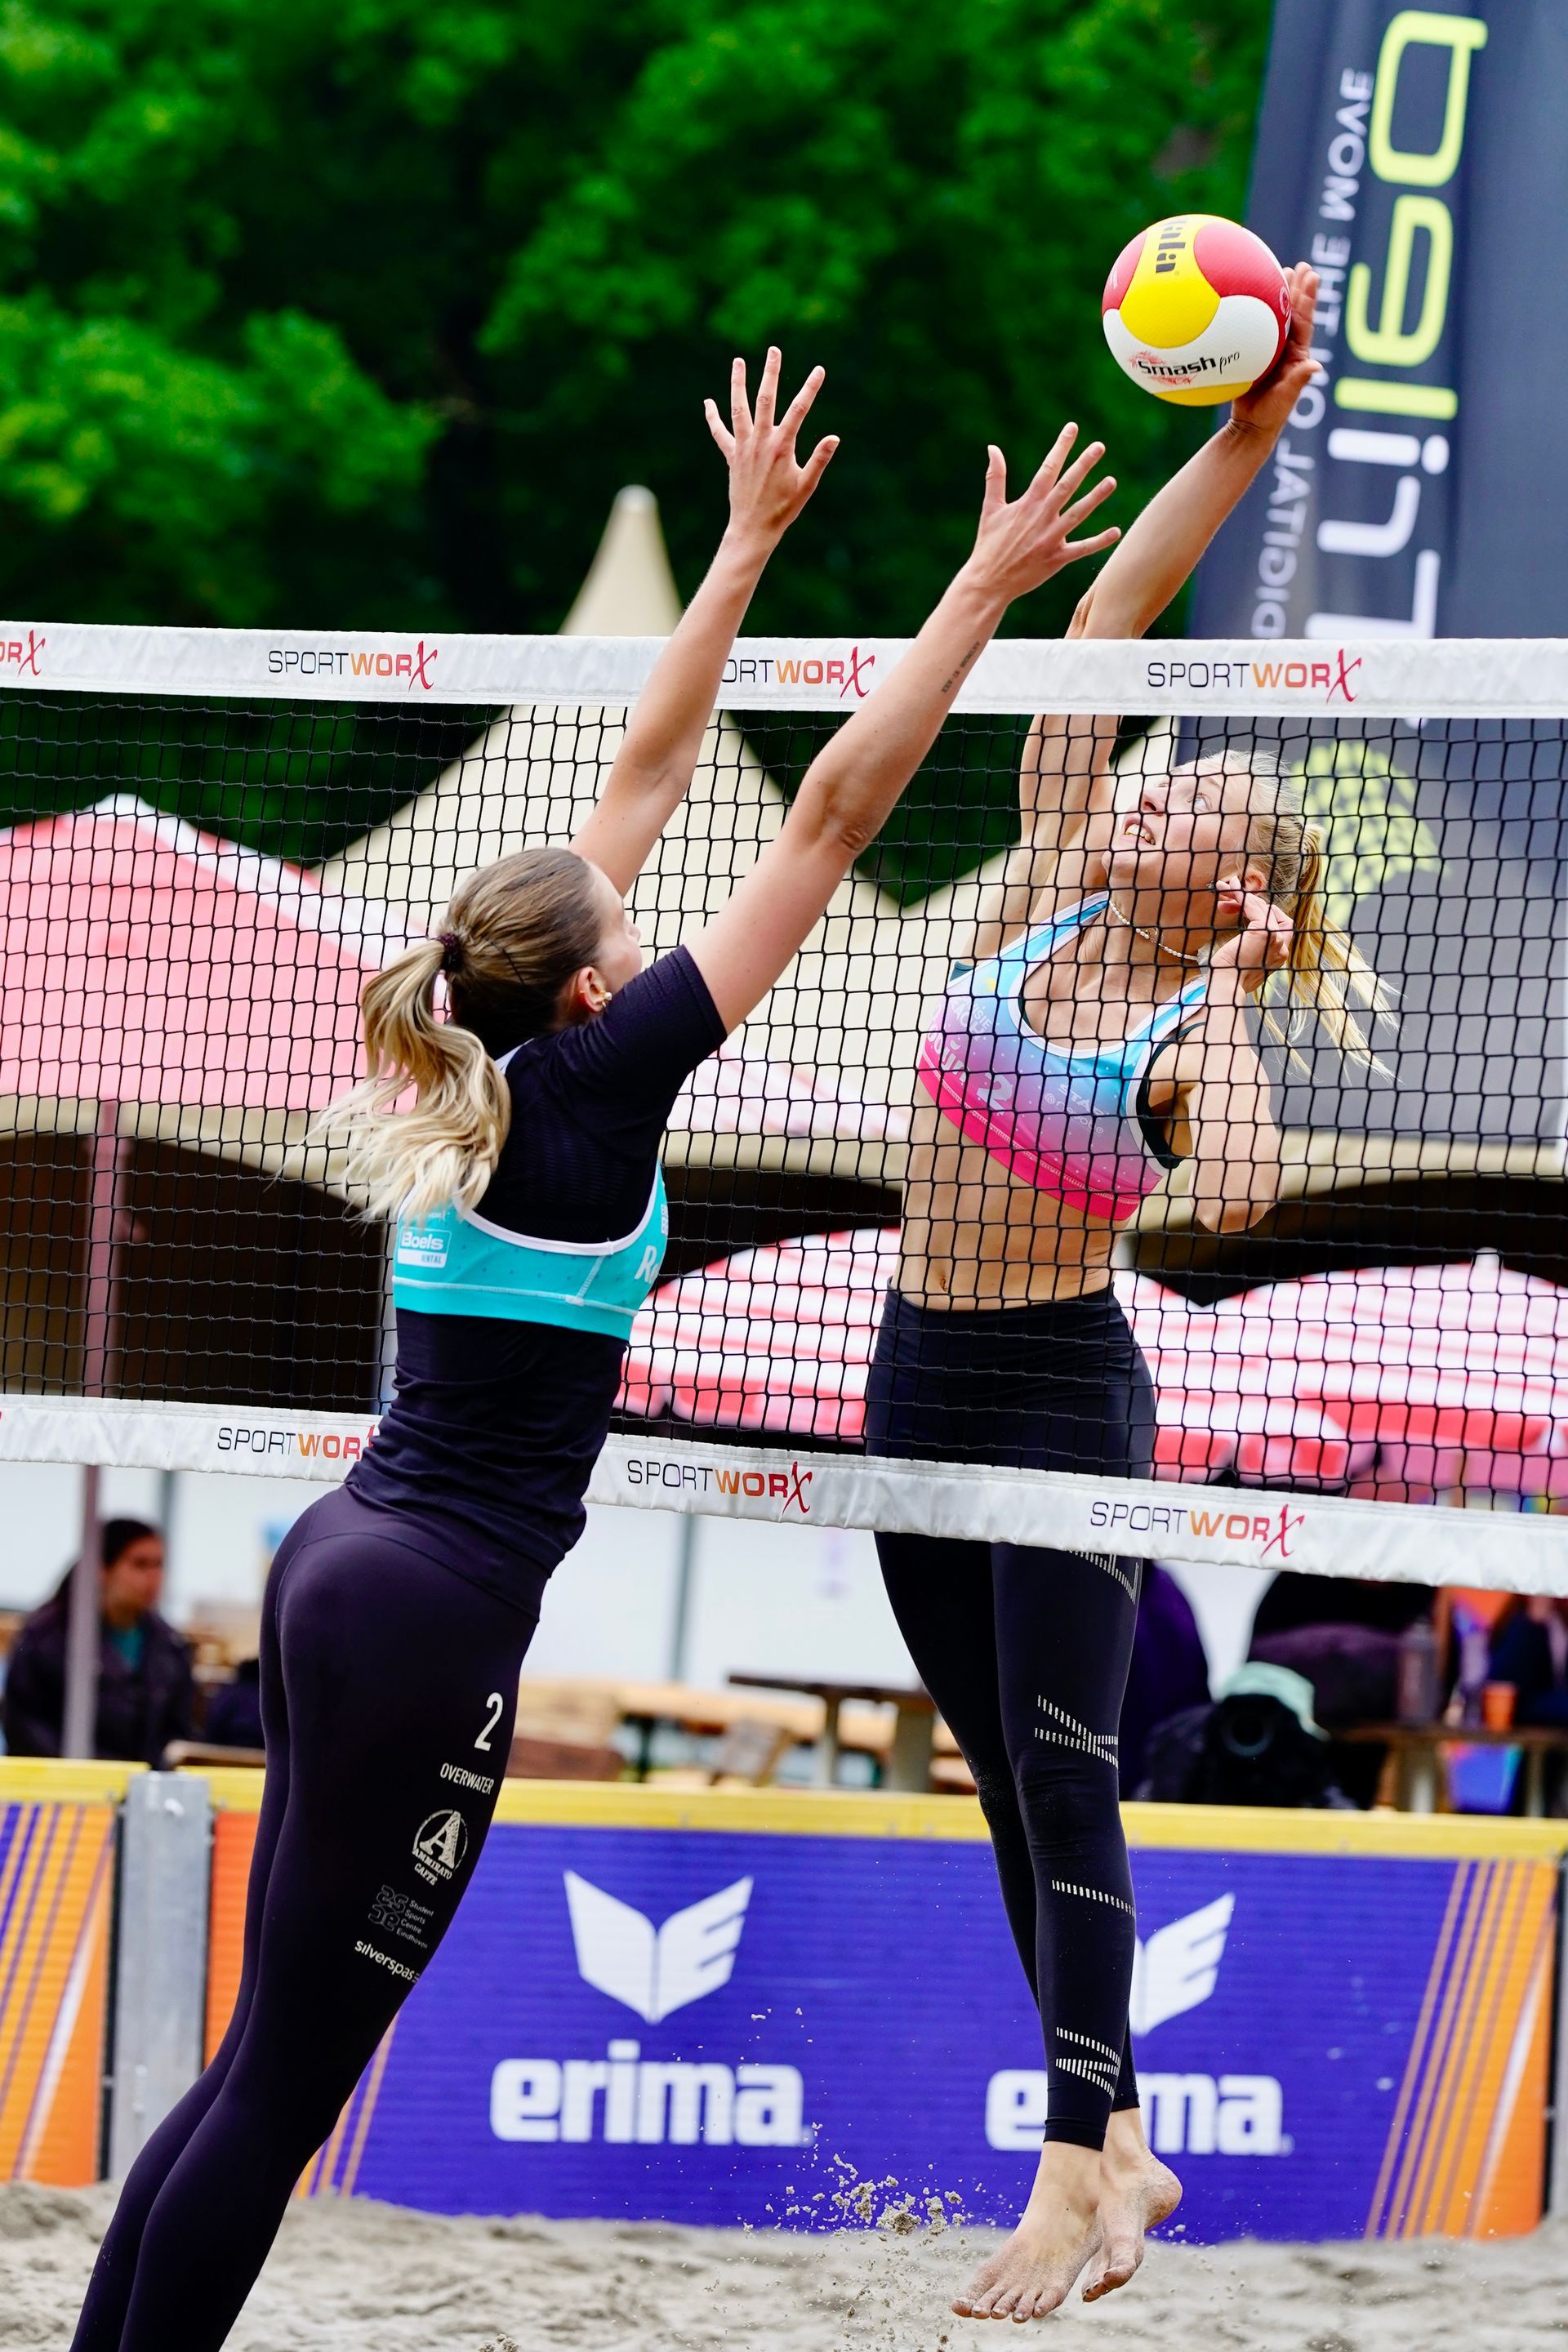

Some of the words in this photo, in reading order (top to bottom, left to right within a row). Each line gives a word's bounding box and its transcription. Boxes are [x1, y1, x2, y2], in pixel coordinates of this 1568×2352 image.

[1138, 356, 1216, 376] Smash
[1218, 351, 1241, 374] pro
[268, 640, 439, 691] SPORTWORX
[722, 646, 875, 699] ORTWORX
[1147, 648, 1362, 703] SPORTWORX
[977, 1072, 1013, 1116] 2
[400, 1232, 444, 1250] Boels
[627, 1460, 813, 1516] SPORTWORX
[1089, 1501, 1304, 1558] SPORTWORX
[474, 1692, 504, 1752] 2
[439, 1762, 495, 1795] OVERWATER
[412, 1847, 452, 1880] AMMIRATO
[400, 1918, 423, 1934] Centre
[404, 1909, 426, 1925] Sports
[409, 1900, 434, 1917] Student
[396, 1927, 428, 1949] Eindhoven
[492, 2039, 804, 2148] erima
[985, 2069, 1283, 2156] ema
